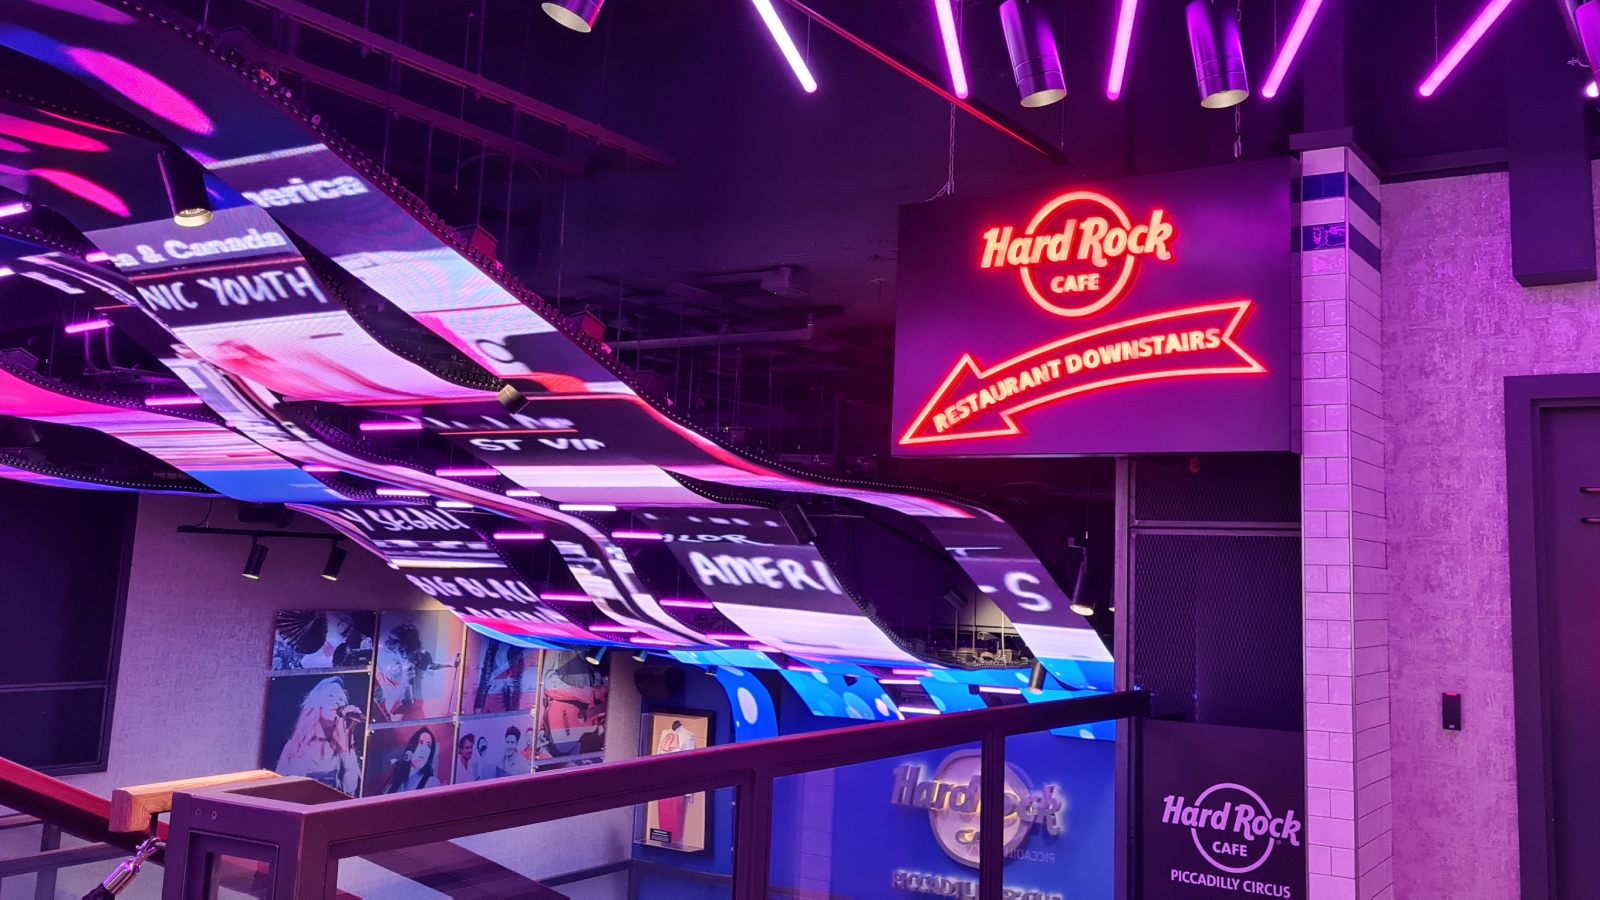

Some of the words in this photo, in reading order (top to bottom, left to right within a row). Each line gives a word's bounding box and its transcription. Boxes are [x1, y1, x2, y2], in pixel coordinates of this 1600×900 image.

[136, 244, 168, 263] &
[163, 228, 287, 259] Canada
[980, 219, 1077, 268] Hard
[1077, 210, 1173, 267] Rock
[196, 266, 329, 306] YOUTH
[1050, 272, 1100, 294] CAFE
[932, 359, 1061, 433] RESTAURANT
[1065, 328, 1221, 375] DOWNSTAIRS
[470, 438, 523, 451] ST
[891, 765, 981, 814] Hard
[1162, 795, 1232, 830] Hard
[1233, 810, 1301, 846] Rock
[1212, 841, 1248, 857] CAFE
[1170, 869, 1240, 890] PICCADILLY
[1242, 880, 1291, 898] CIRCUS
